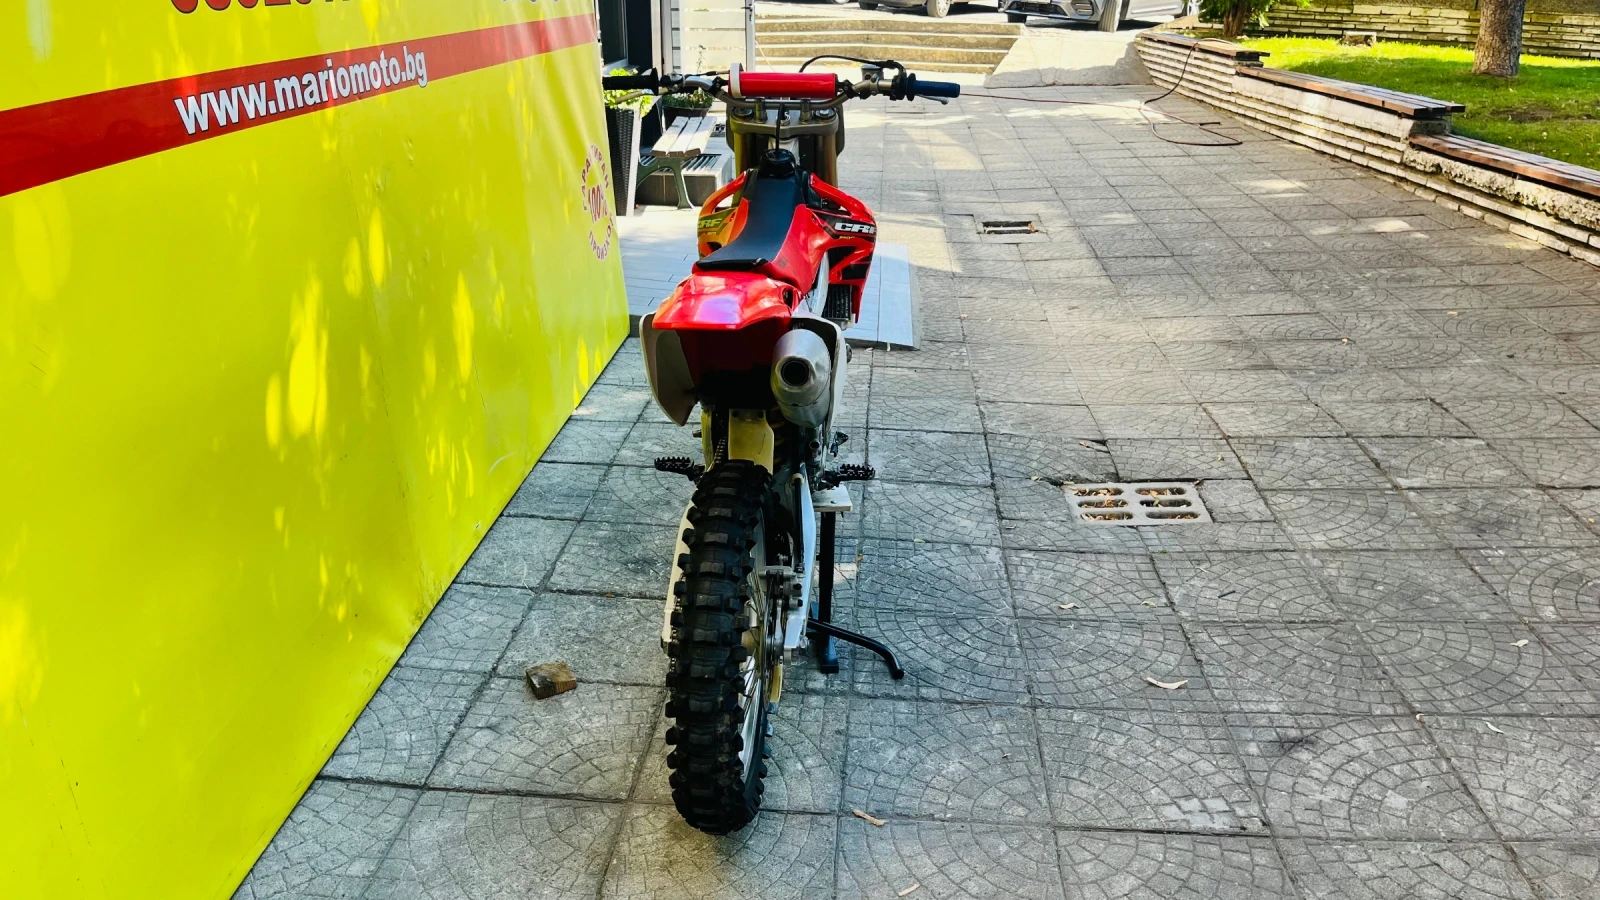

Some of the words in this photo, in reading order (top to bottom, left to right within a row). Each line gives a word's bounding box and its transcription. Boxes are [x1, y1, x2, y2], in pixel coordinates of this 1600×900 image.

[173, 45, 428, 135] www.mariomoto.bg
[581, 144, 609, 211] ГАРАИРАН
[697, 218, 723, 229] RF
